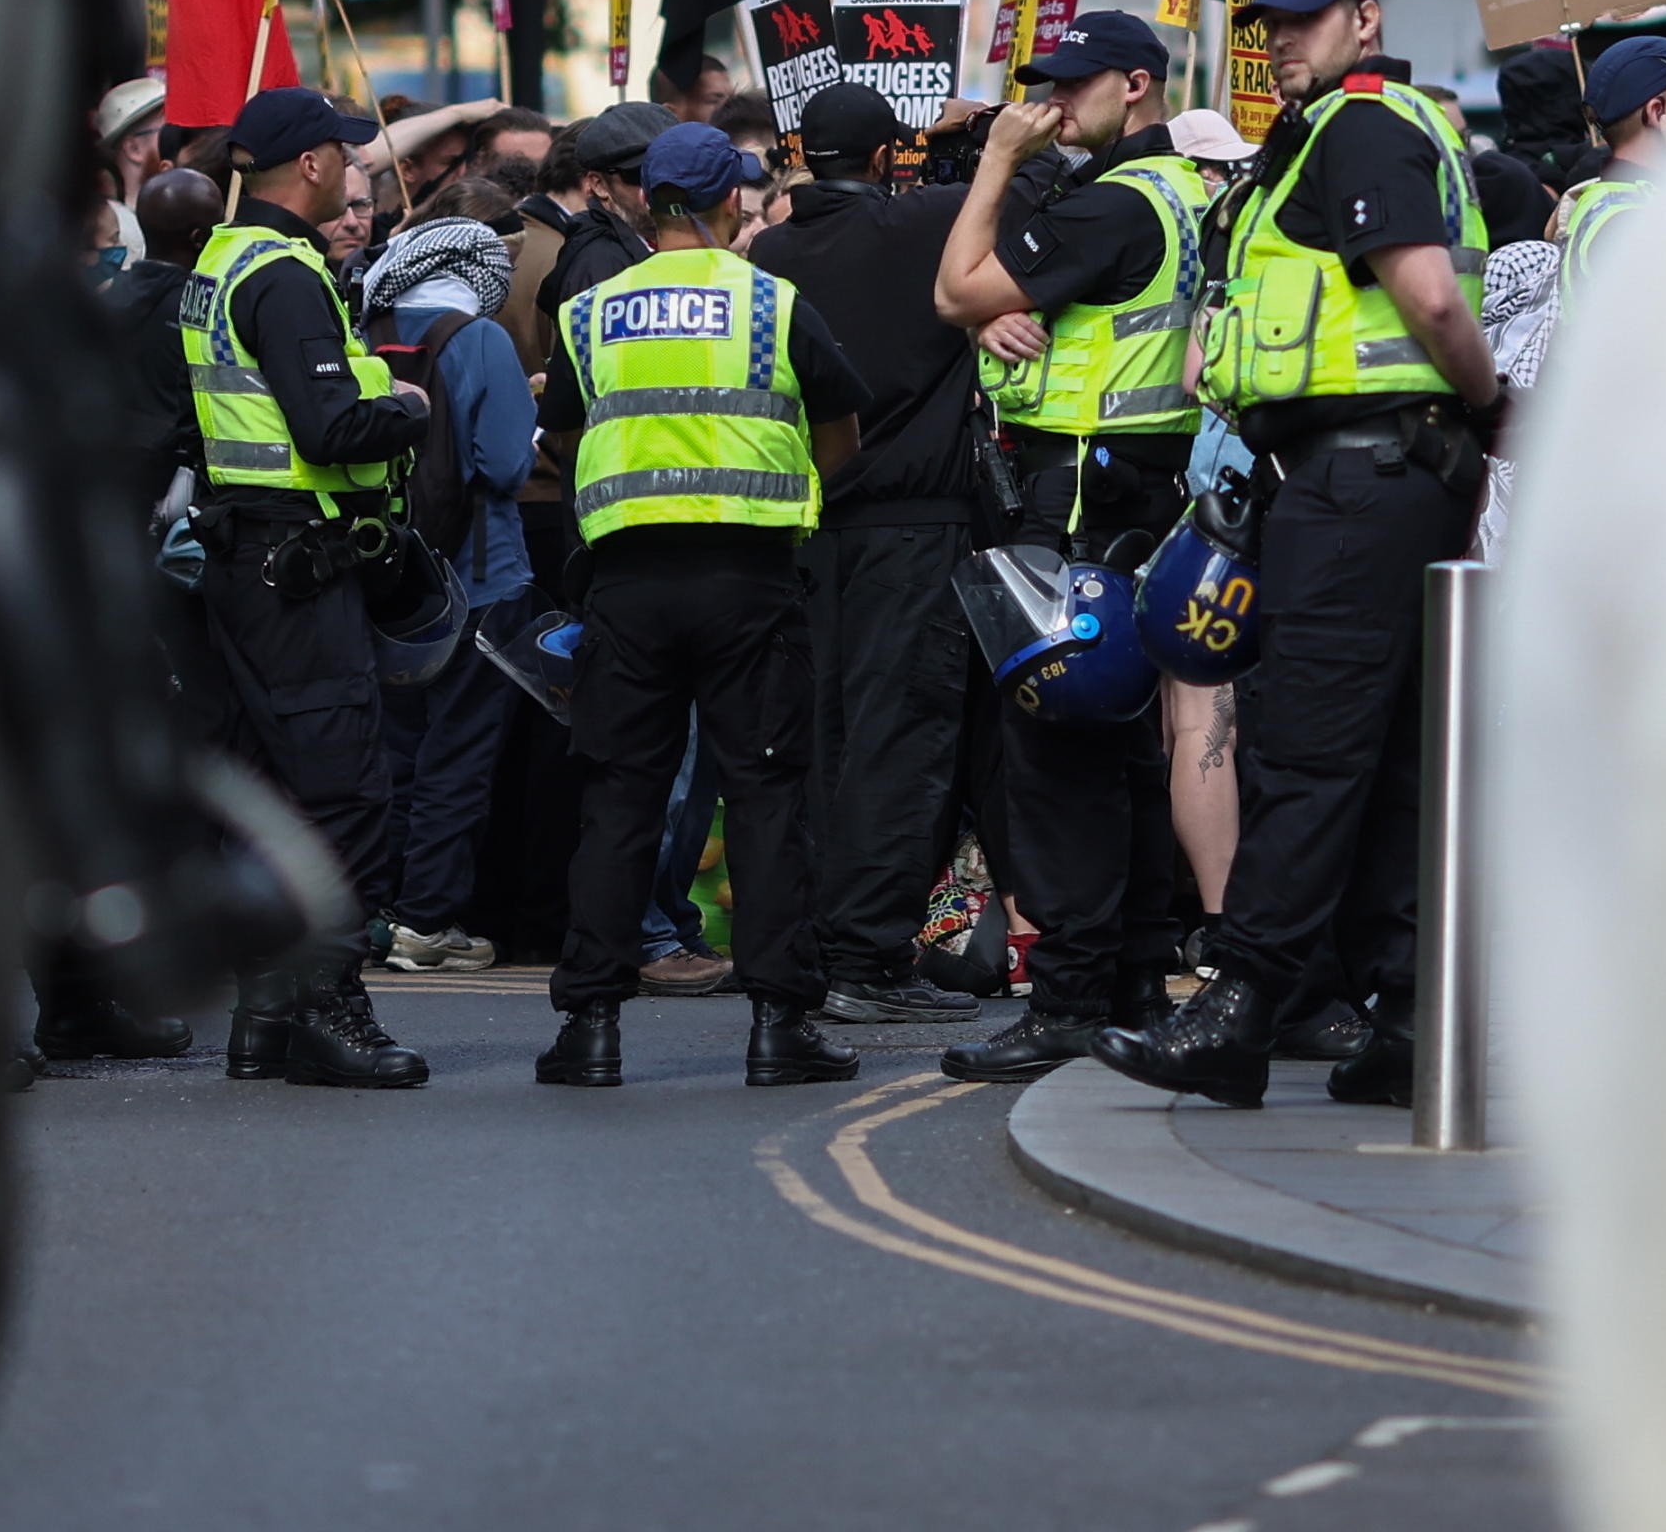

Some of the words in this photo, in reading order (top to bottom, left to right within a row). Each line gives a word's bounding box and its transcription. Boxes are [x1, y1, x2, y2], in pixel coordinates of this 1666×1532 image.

[1059, 30, 1089, 45] LICE
[1231, 17, 1268, 51] FASC
[766, 45, 841, 100] REFUGEES
[1244, 60, 1274, 95] RAC
[889, 96, 943, 129] COME
[604, 292, 725, 335] POLICE
